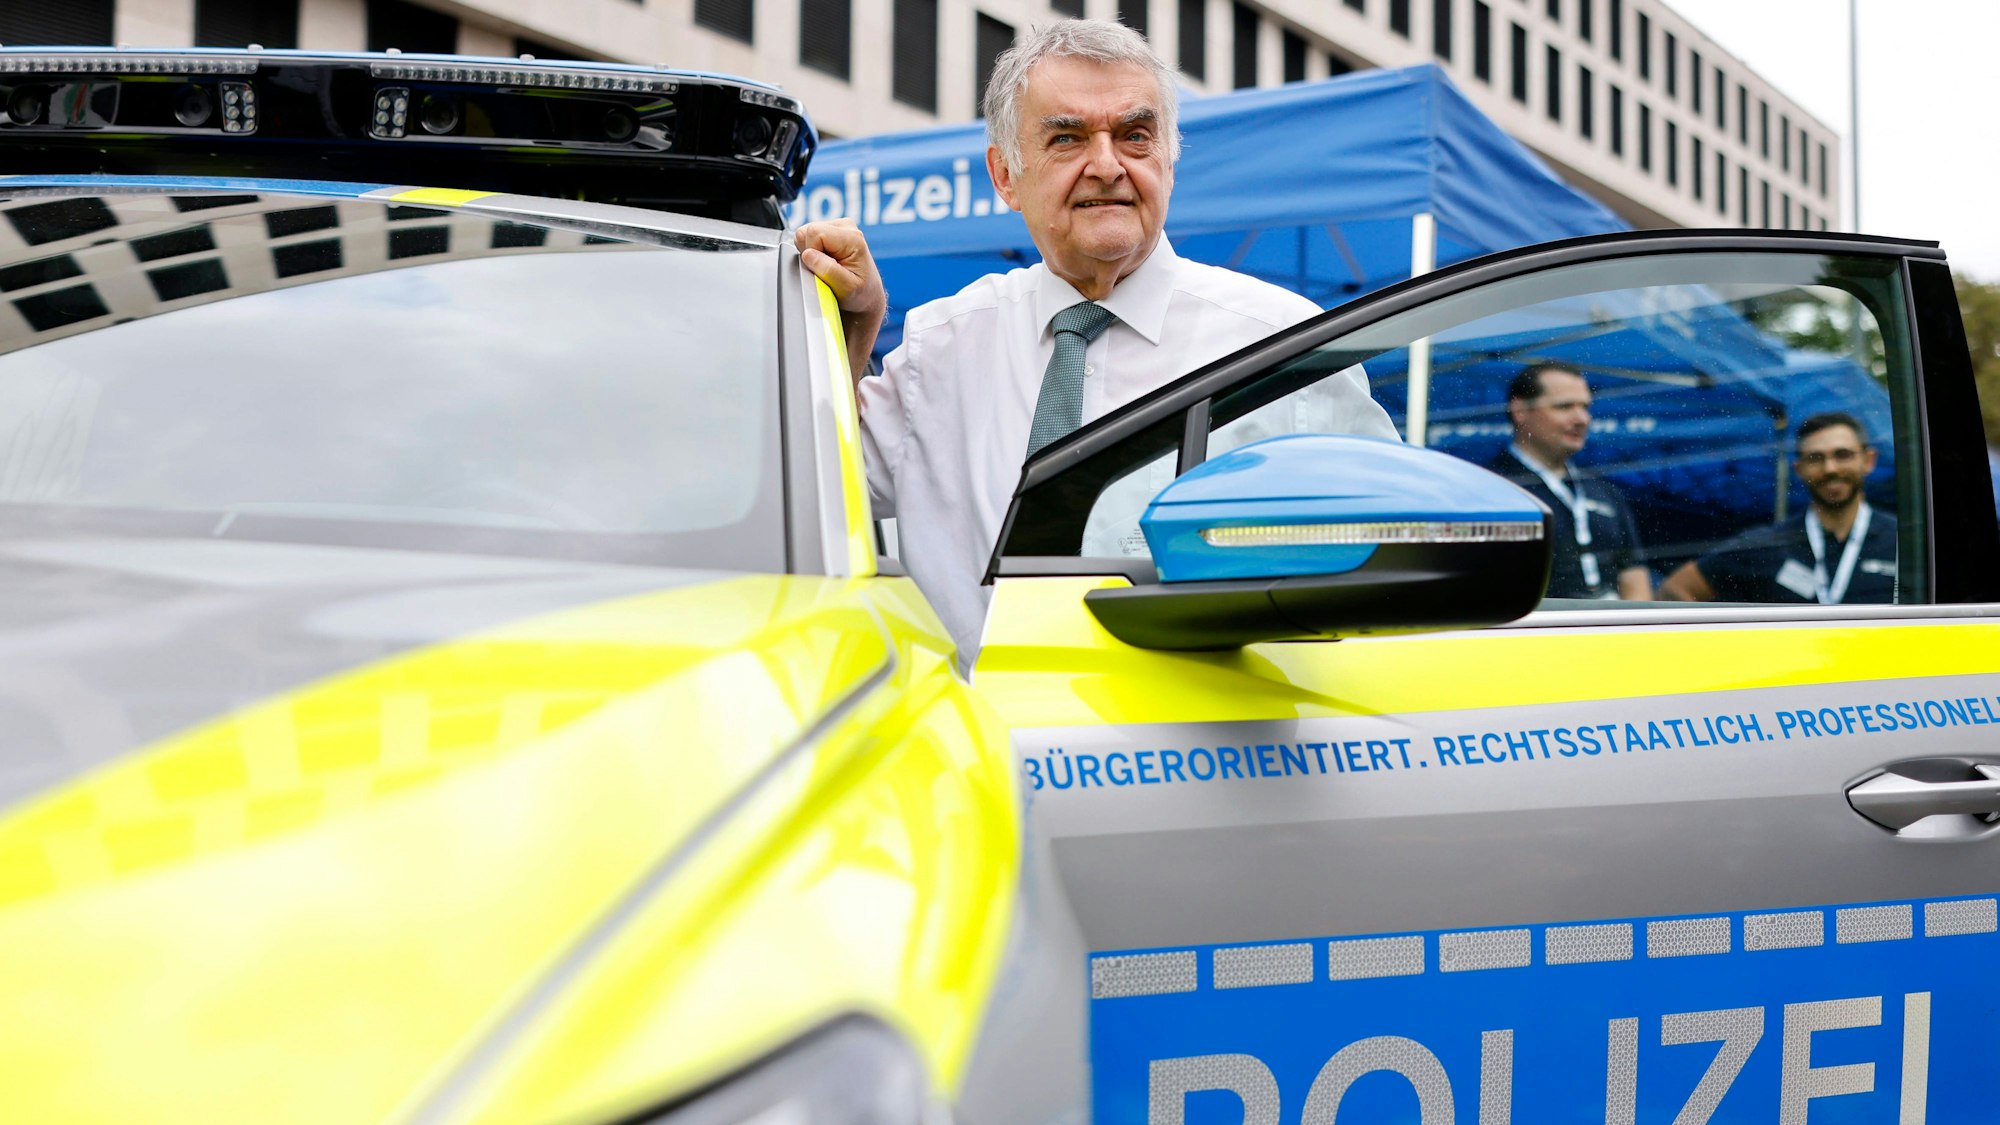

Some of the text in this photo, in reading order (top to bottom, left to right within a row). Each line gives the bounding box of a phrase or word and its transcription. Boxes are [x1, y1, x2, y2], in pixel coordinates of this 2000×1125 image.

[783, 157, 1011, 228] olizei.
[1024, 696, 2000, 791] BÜRGERORIENTIERT. RECHTSSTAATLICH. PROFESSIONEL
